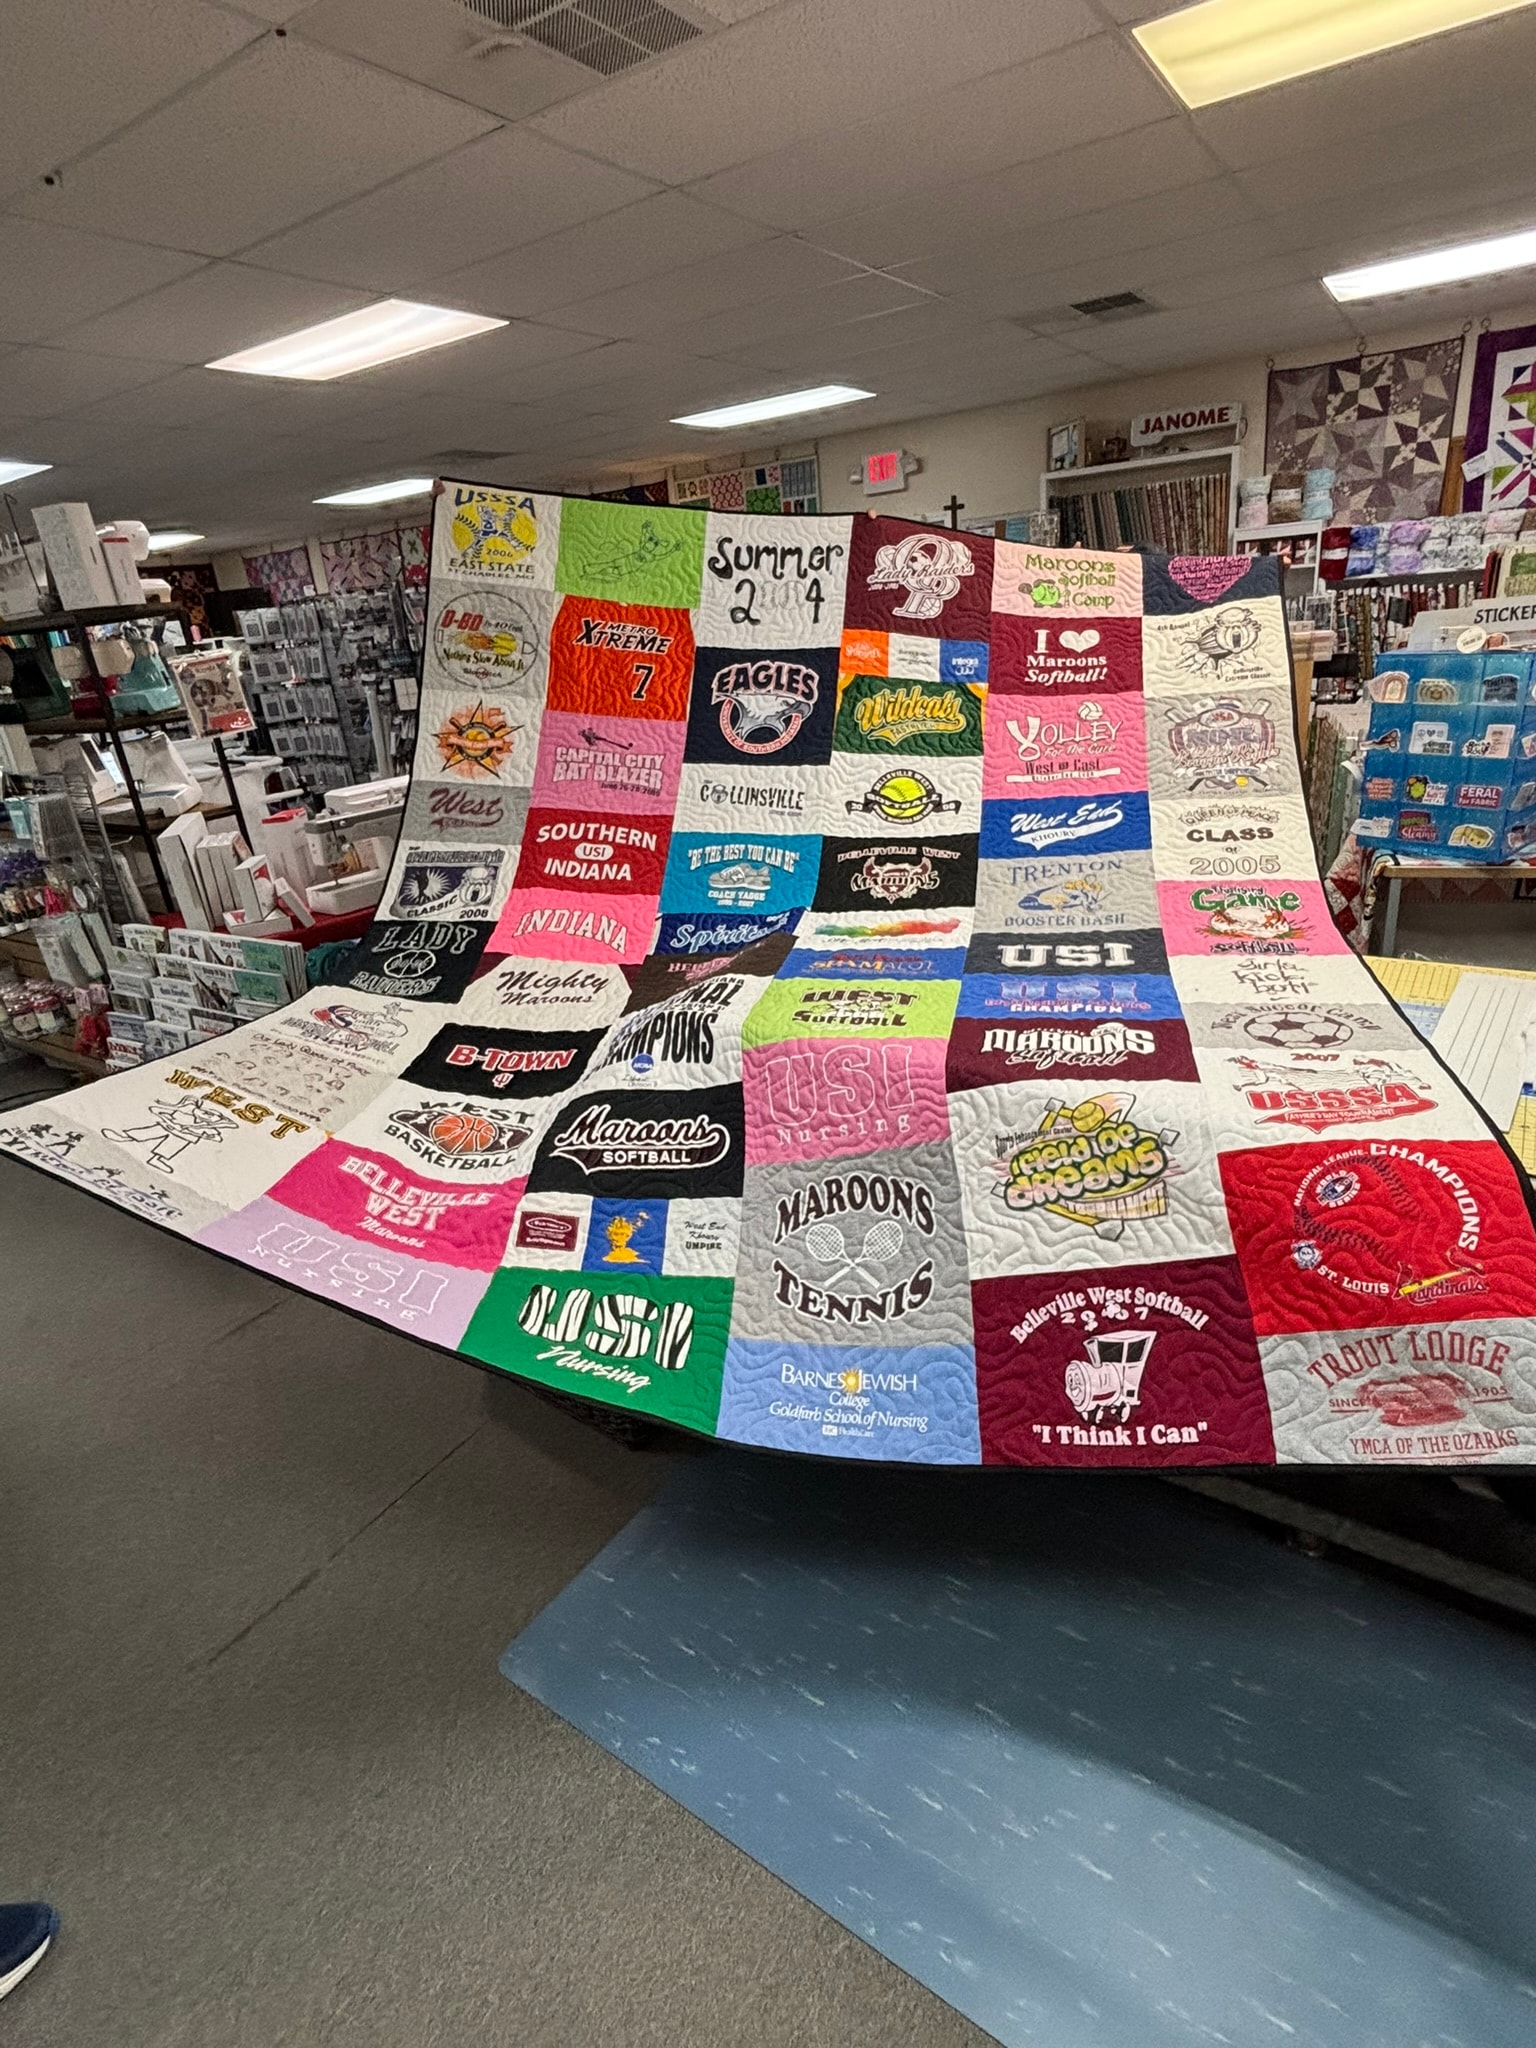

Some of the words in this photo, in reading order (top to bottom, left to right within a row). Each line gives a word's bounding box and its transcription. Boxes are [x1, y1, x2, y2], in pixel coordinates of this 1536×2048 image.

[1140, 406, 1231, 436] JANOME
[869, 453, 896, 483] EXIT
[454, 488, 537, 519] USSSA
[449, 558, 485, 570] EAST
[488, 561, 535, 573] STATE
[707, 536, 844, 580] Summer
[1025, 554, 1116, 574] Maroons
[867, 562, 913, 583] Lady
[916, 562, 975, 578] Raiders
[1058, 571, 1116, 588] Softball
[1071, 590, 1116, 608] Camp
[574, 619, 672, 655] XTREME
[607, 621, 657, 636] METRO
[1034, 629, 1049, 653] I
[1026, 654, 1107, 668] Maroons
[631, 665, 654, 700] 7
[713, 661, 818, 702] EAGLES
[1025, 667, 1107, 686] Softball!
[855, 686, 962, 734] Wildcats
[556, 747, 622, 767] CAPITAL
[625, 754, 665, 770] CITY
[1044, 747, 1062, 757] For
[1066, 744, 1085, 755] The
[1087, 742, 1116, 754] Cure
[552, 762, 591, 783] BAT
[593, 765, 663, 790] BLAZER
[1025, 761, 1054, 775] West
[1073, 758, 1100, 771] East
[429, 787, 504, 818] West
[1460, 787, 1499, 799] FERAL
[1470, 799, 1498, 807] FABRIC
[1010, 811, 1068, 834] West
[1067, 800, 1123, 825] End
[536, 823, 657, 852] SOUTHERN
[1030, 829, 1077, 843] KHOURY
[1186, 827, 1274, 843] CLASS
[582, 846, 607, 858] USI
[704, 846, 722, 864] THE
[723, 844, 747, 862] BEST
[747, 844, 765, 860] YOU
[765, 847, 783, 865] CAN
[837, 846, 917, 863] BELLEVILLE
[921, 846, 961, 860] WEST
[1189, 854, 1281, 876] 2005
[544, 857, 634, 881] INDIANA
[1008, 860, 1123, 886] TRENTON
[406, 894, 458, 919] CLASSIC
[458, 908, 489, 920] 2008
[707, 890, 736, 899] COACH
[1190, 888, 1301, 912] Game
[513, 909, 628, 956] INDIANA
[1004, 915, 1077, 928] BOOSTER
[1081, 913, 1125, 927] BASH
[371, 921, 478, 955] LADY
[998, 942, 1136, 968] USI
[349, 971, 443, 996] RAIDERS
[497, 969, 609, 997] Mighty
[1000, 978, 1137, 1001] USI
[501, 992, 594, 1006] Maroons
[800, 989, 919, 1007] WEST
[1010, 1004, 1123, 1014] CHAMPION
[1211, 1010, 1244, 1030] West
[1249, 1002, 1323, 1014] Soccer
[1325, 1007, 1383, 1031] Camp
[980, 1027, 1156, 1055] MAROONS
[446, 1045, 577, 1072] B-TOWN
[1290, 1053, 1341, 1061] 2007
[765, 1044, 915, 1127] USI
[1247, 1083, 1420, 1110] USSSA
[165, 1068, 311, 1141] WEST
[419, 1100, 536, 1125] WEST
[1284, 1112, 1321, 1121] FATHER'S
[1321, 1111, 1340, 1121] DAY
[553, 1104, 718, 1147] Maroons
[777, 1113, 910, 1146] Nursing
[383, 1124, 517, 1171] BASKETBALL
[602, 1150, 691, 1165] SOFTBALL
[339, 1156, 496, 1207] BELLEVILLE
[1294, 1166, 1324, 1207] NATIONAL
[1323, 1149, 1364, 1165] LEAGUE
[1315, 1169, 1348, 1194] WORLD
[1328, 1182, 1362, 1208] SERIES
[1369, 1143, 1481, 1251] CHAMPIONS
[364, 1191, 447, 1232] WEST
[773, 1173, 936, 1247] MAROONS
[356, 1217, 426, 1249] Maroons
[684, 1219, 706, 1230] West
[708, 1221, 728, 1231] End
[685, 1241, 722, 1251] UMPIRE
[257, 1222, 450, 1316] USI
[1317, 1264, 1338, 1284] ST.
[1341, 1281, 1390, 1295] LOUIS
[773, 1258, 935, 1324] TENNIS
[518, 1284, 695, 1371] USI
[1010, 1291, 1087, 1345] Belleville
[1087, 1286, 1132, 1306] West
[1134, 1287, 1210, 1332] Softball
[536, 1345, 652, 1394] Nursing
[1307, 1333, 1399, 1390] TROUT
[1407, 1330, 1512, 1376] LODGE
[781, 1363, 847, 1389] BARNES
[857, 1369, 918, 1393] JEWISH
[829, 1392, 871, 1411] College
[1474, 1386, 1508, 1398] 1905
[769, 1400, 822, 1421] Goldfarb
[823, 1408, 862, 1425] School
[863, 1411, 877, 1430] of
[877, 1412, 929, 1433] Nursing
[1032, 1424, 1052, 1444] "I
[1056, 1425, 1133, 1447] Think
[1136, 1426, 1147, 1446] I
[1150, 1421, 1209, 1445] Can"
[1350, 1437, 1393, 1456] YMCA
[1395, 1437, 1414, 1455] OF
[1416, 1435, 1451, 1455] THE
[1452, 1429, 1521, 1451] OZARKS
